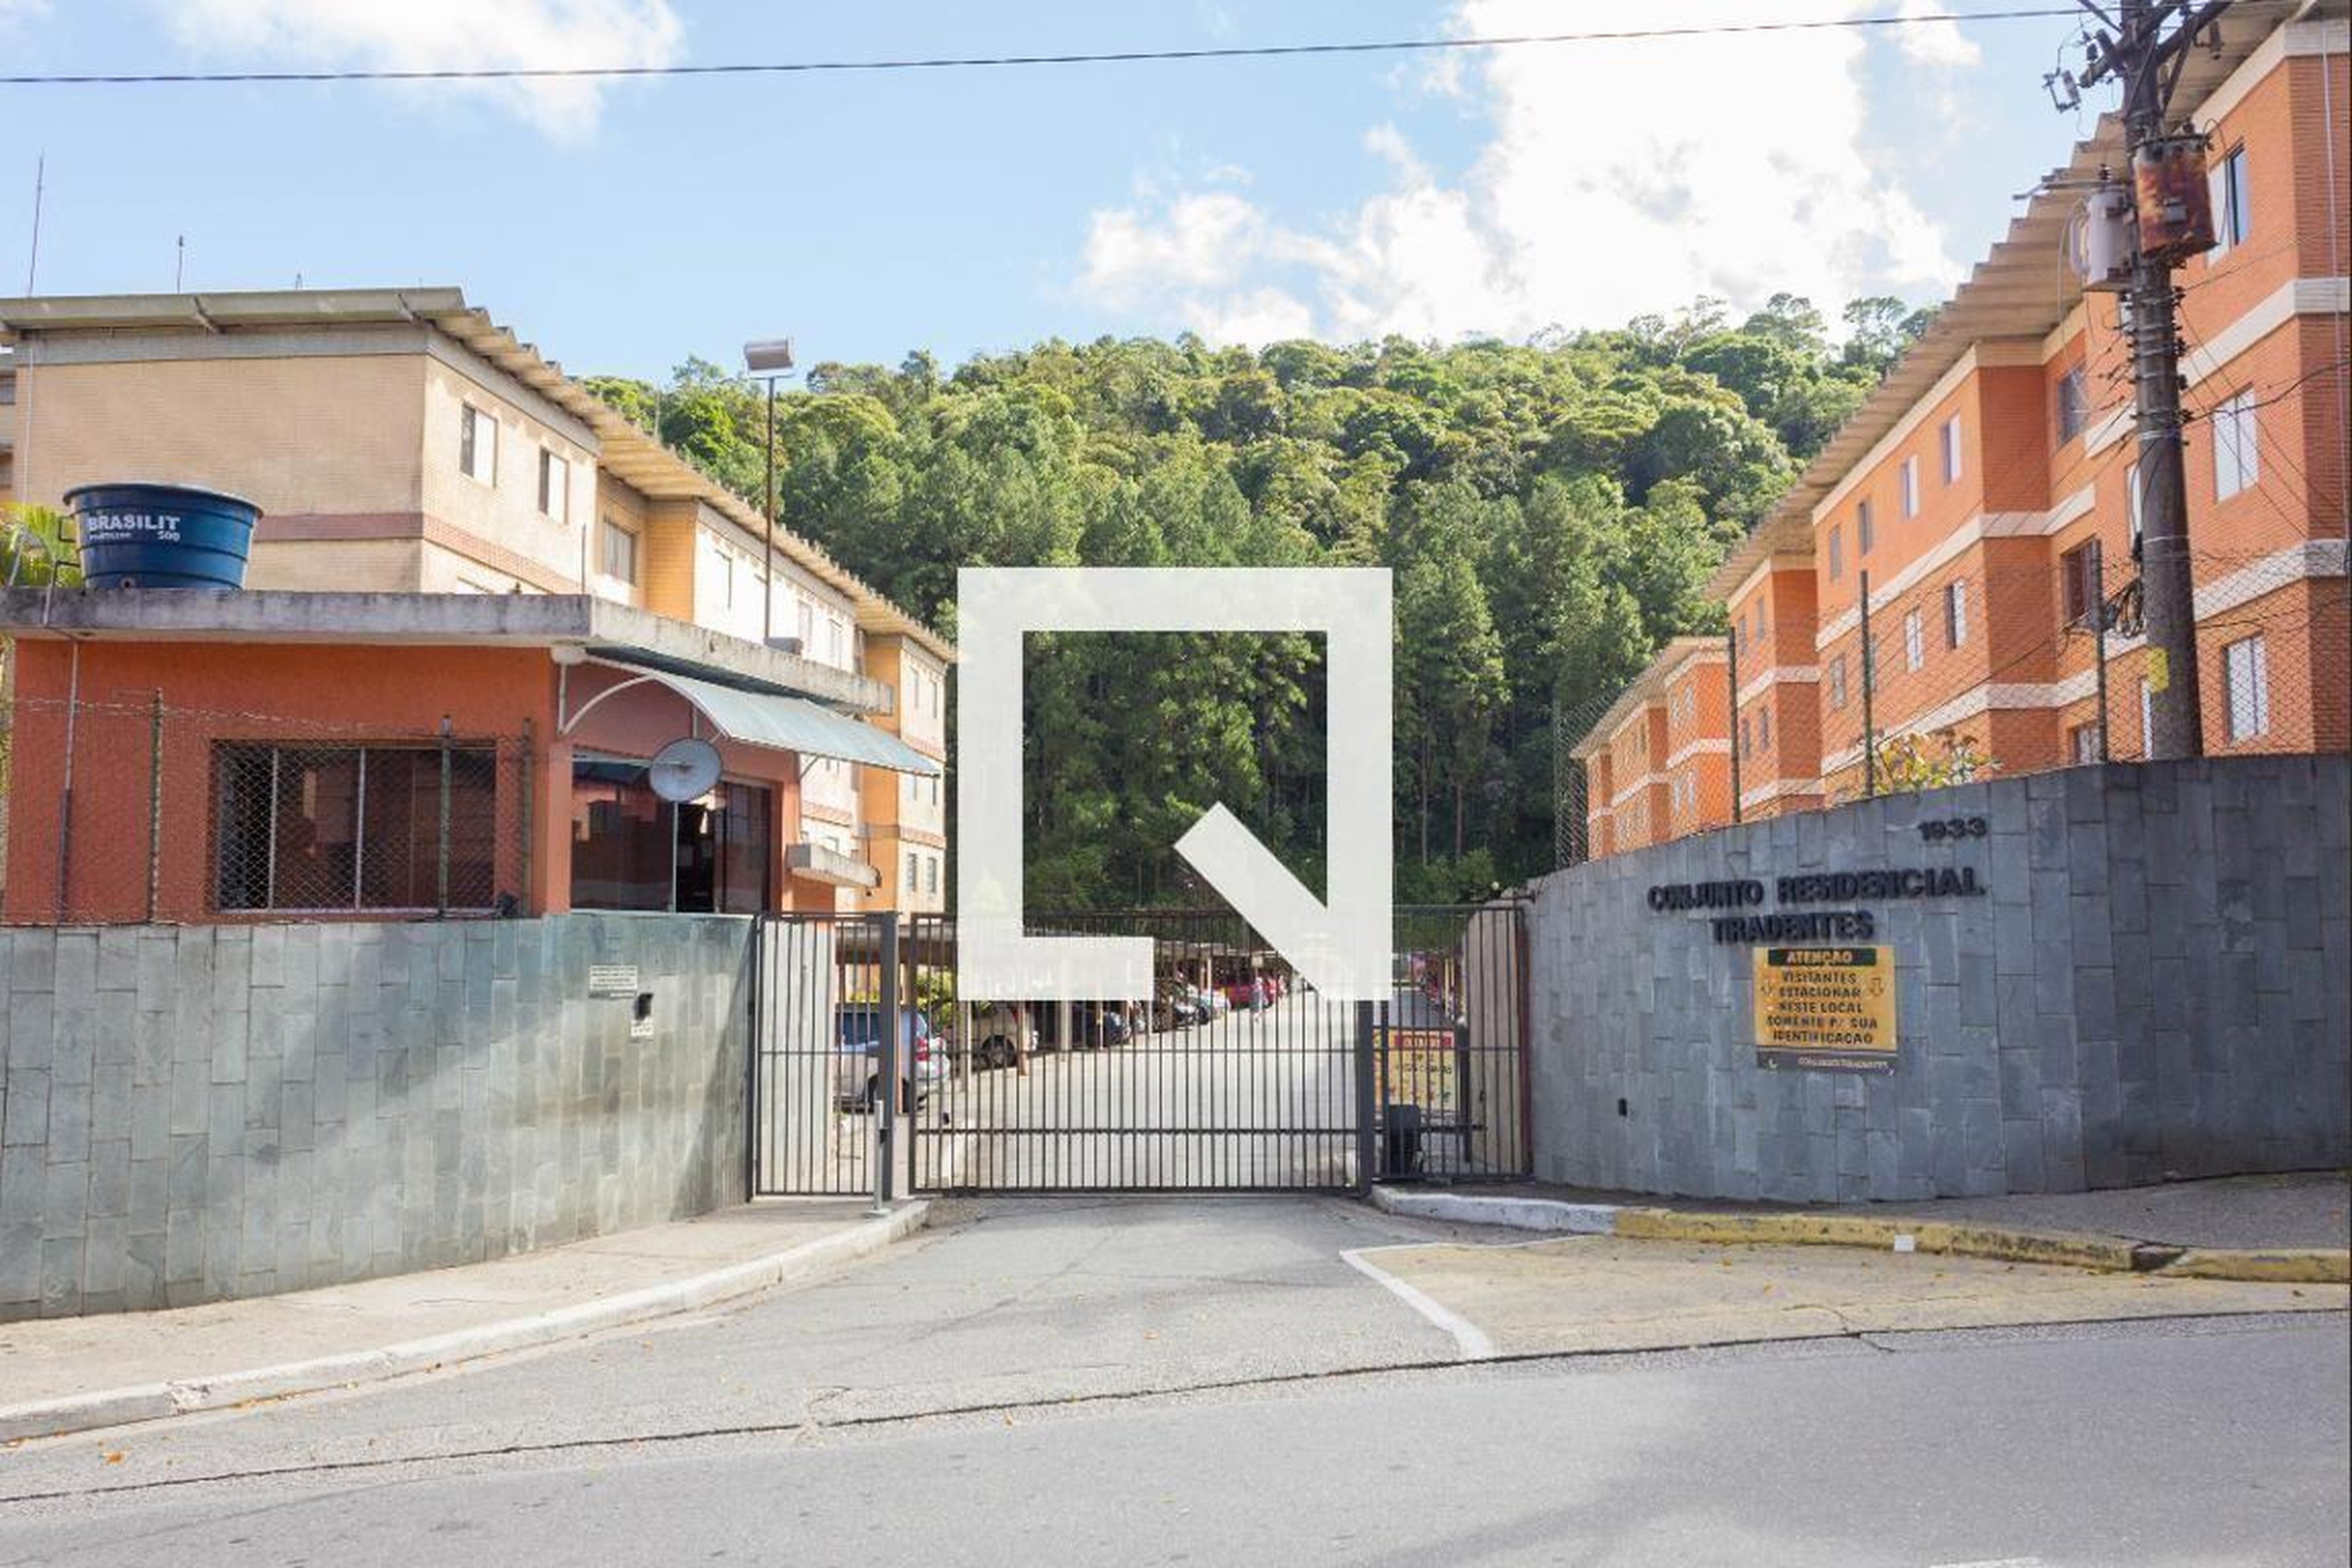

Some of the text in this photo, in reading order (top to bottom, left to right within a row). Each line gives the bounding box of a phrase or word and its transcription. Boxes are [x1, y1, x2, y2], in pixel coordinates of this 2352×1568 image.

[88, 514, 181, 531] BRASILIT
[1646, 866, 1986, 911] CONJUNTO RESIDENCIAL
[1782, 971, 1858, 984] VISITANTES
[1779, 987, 1861, 998] ESTACIONAR
[1779, 1001, 1863, 1014] NESTE LOCAL
[1766, 1014, 1825, 1028] SOMENTE
[1850, 1018, 1878, 1030] SUA
